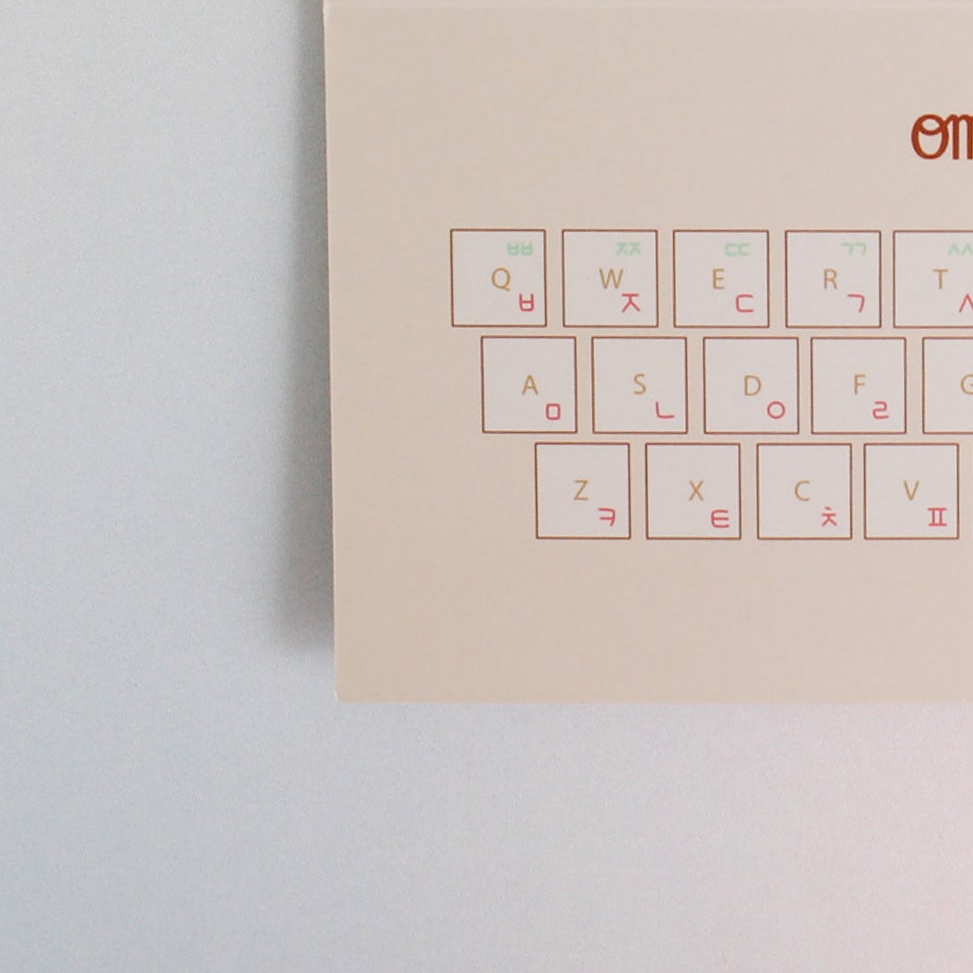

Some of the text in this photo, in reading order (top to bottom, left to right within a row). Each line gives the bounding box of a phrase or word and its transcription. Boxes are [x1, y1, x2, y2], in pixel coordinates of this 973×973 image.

[491, 267, 511, 291] Q
[599, 268, 624, 289] W
[713, 268, 725, 290] E
[824, 268, 837, 289] R
[933, 269, 948, 290] T
[522, 375, 538, 395] A
[634, 373, 647, 395] S
[744, 375, 762, 396] D
[854, 374, 866, 395] F
[574, 479, 589, 501] Z
[689, 480, 704, 501] X
[794, 480, 810, 501] C
[903, 480, 919, 501] V
